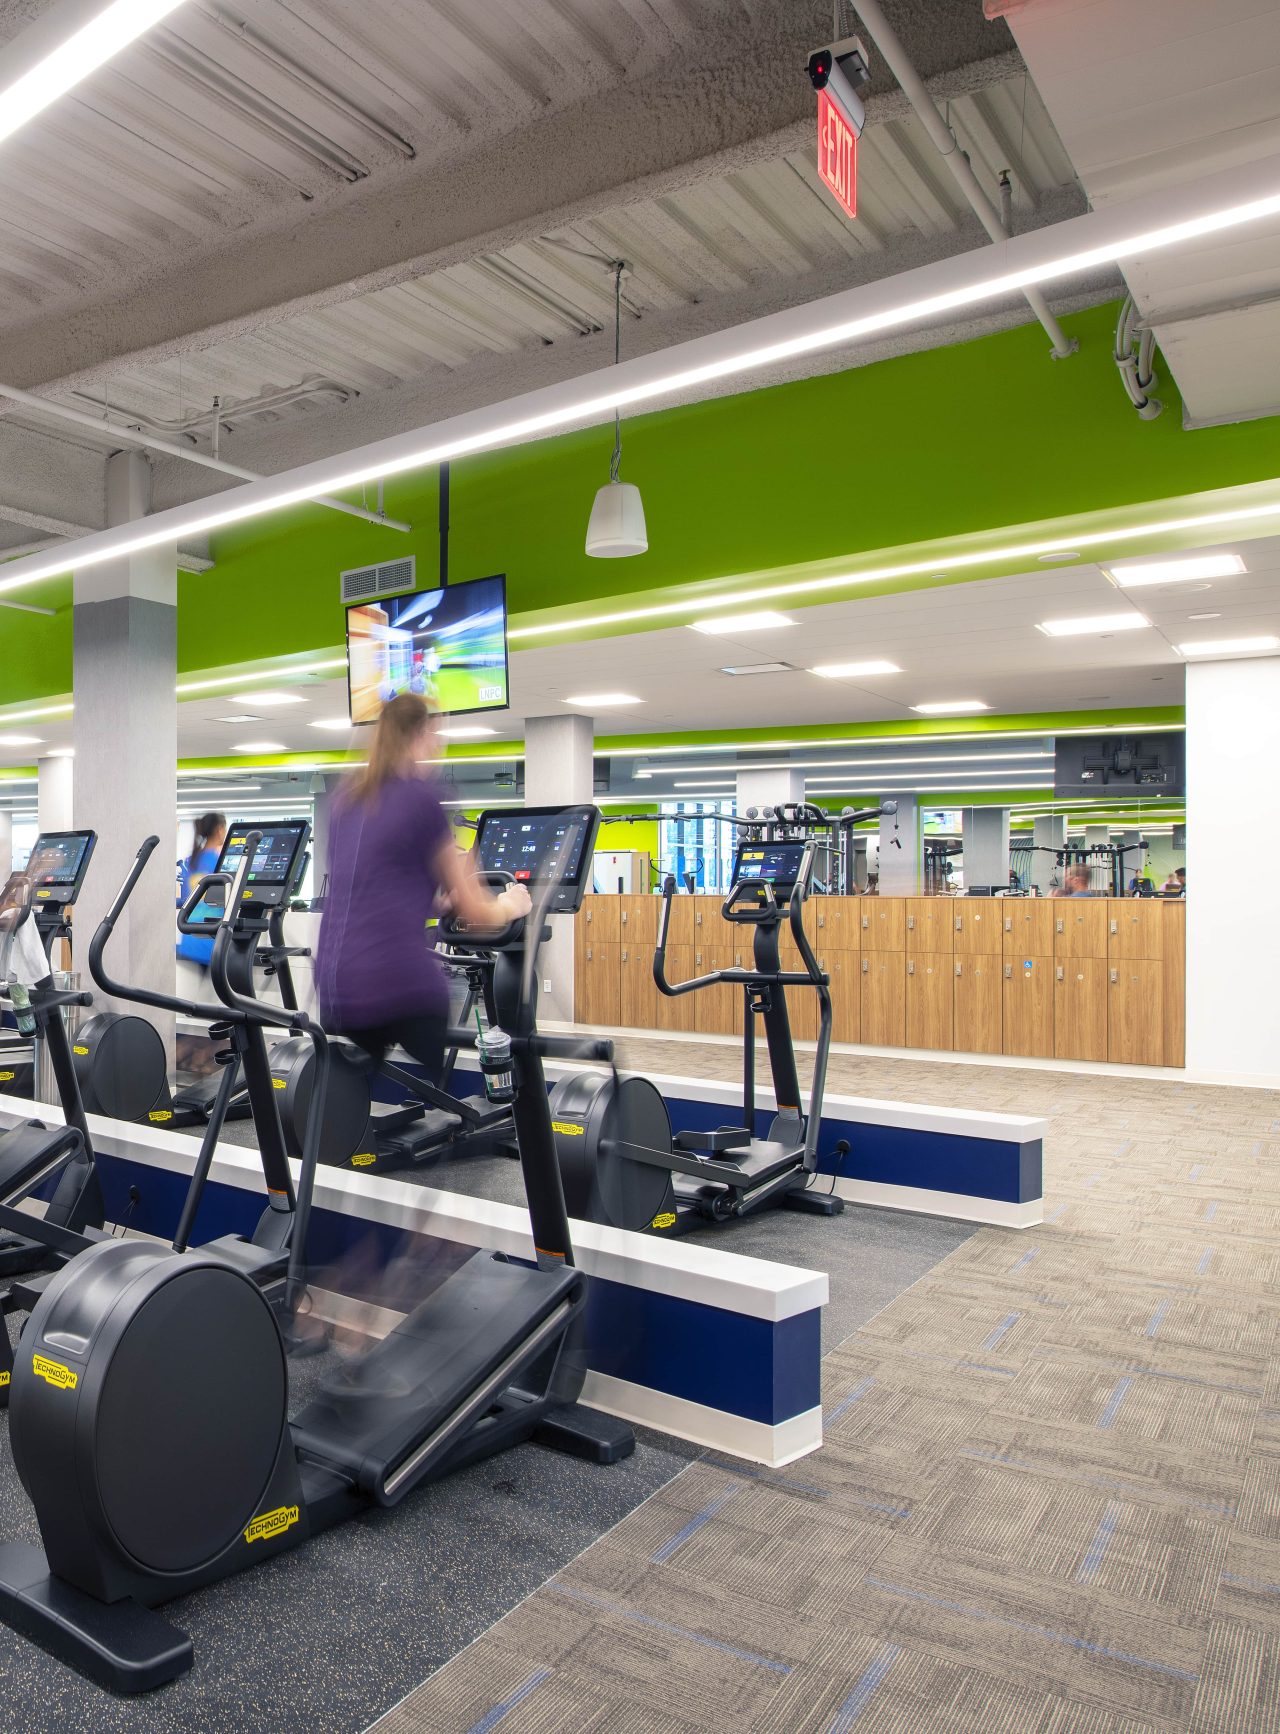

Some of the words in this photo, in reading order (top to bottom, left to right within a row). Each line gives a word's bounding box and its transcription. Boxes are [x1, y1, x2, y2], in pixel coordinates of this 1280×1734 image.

[827, 103, 853, 207] EXIT
[34, 1356, 77, 1386] TECHNOGYM
[247, 1509, 297, 1540] TECHNOGYM
